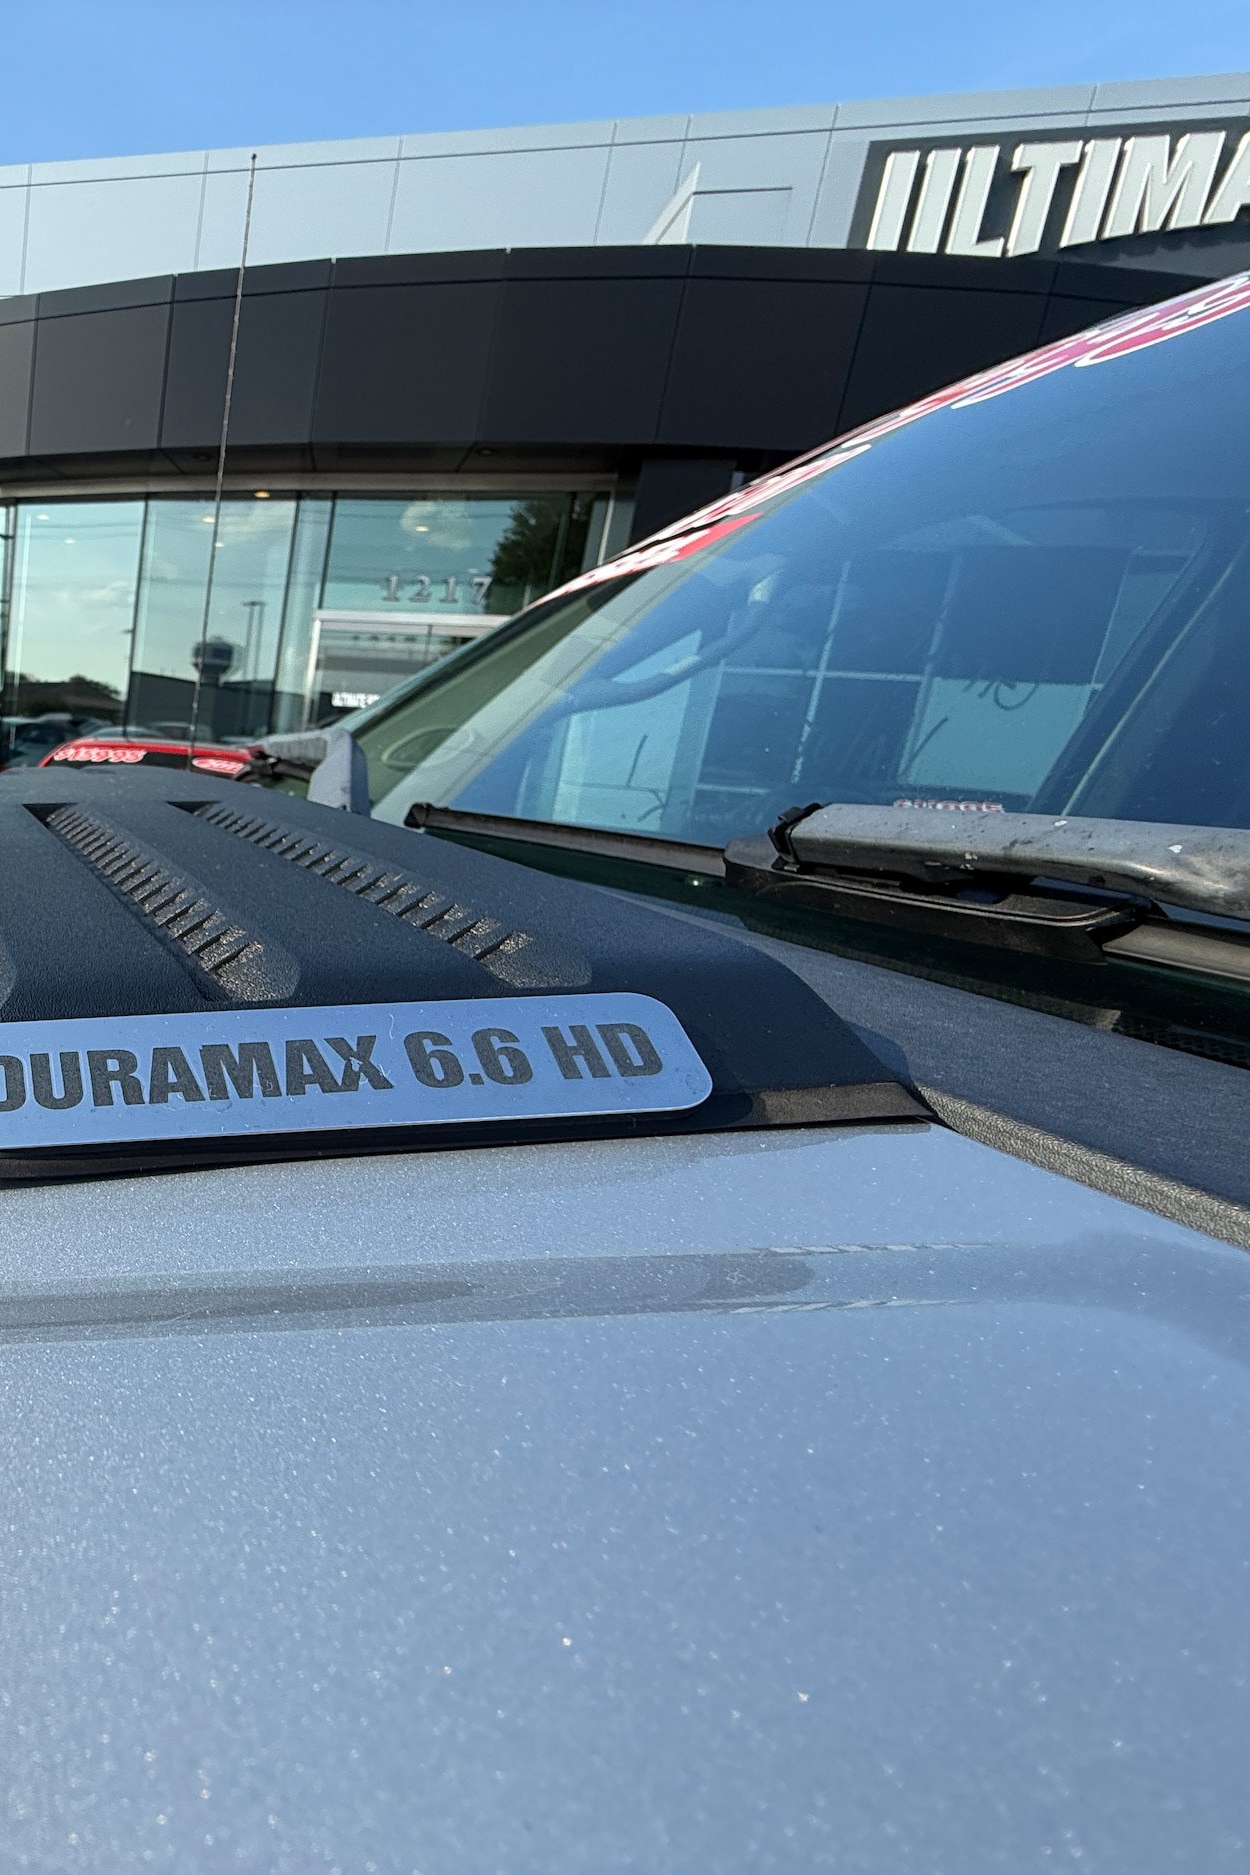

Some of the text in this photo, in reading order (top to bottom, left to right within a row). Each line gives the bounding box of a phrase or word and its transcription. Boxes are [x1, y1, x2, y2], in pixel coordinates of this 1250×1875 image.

[382, 574, 493, 604] 1217
[403, 1026, 535, 1089] 6.6
[541, 1021, 663, 1081] HD
